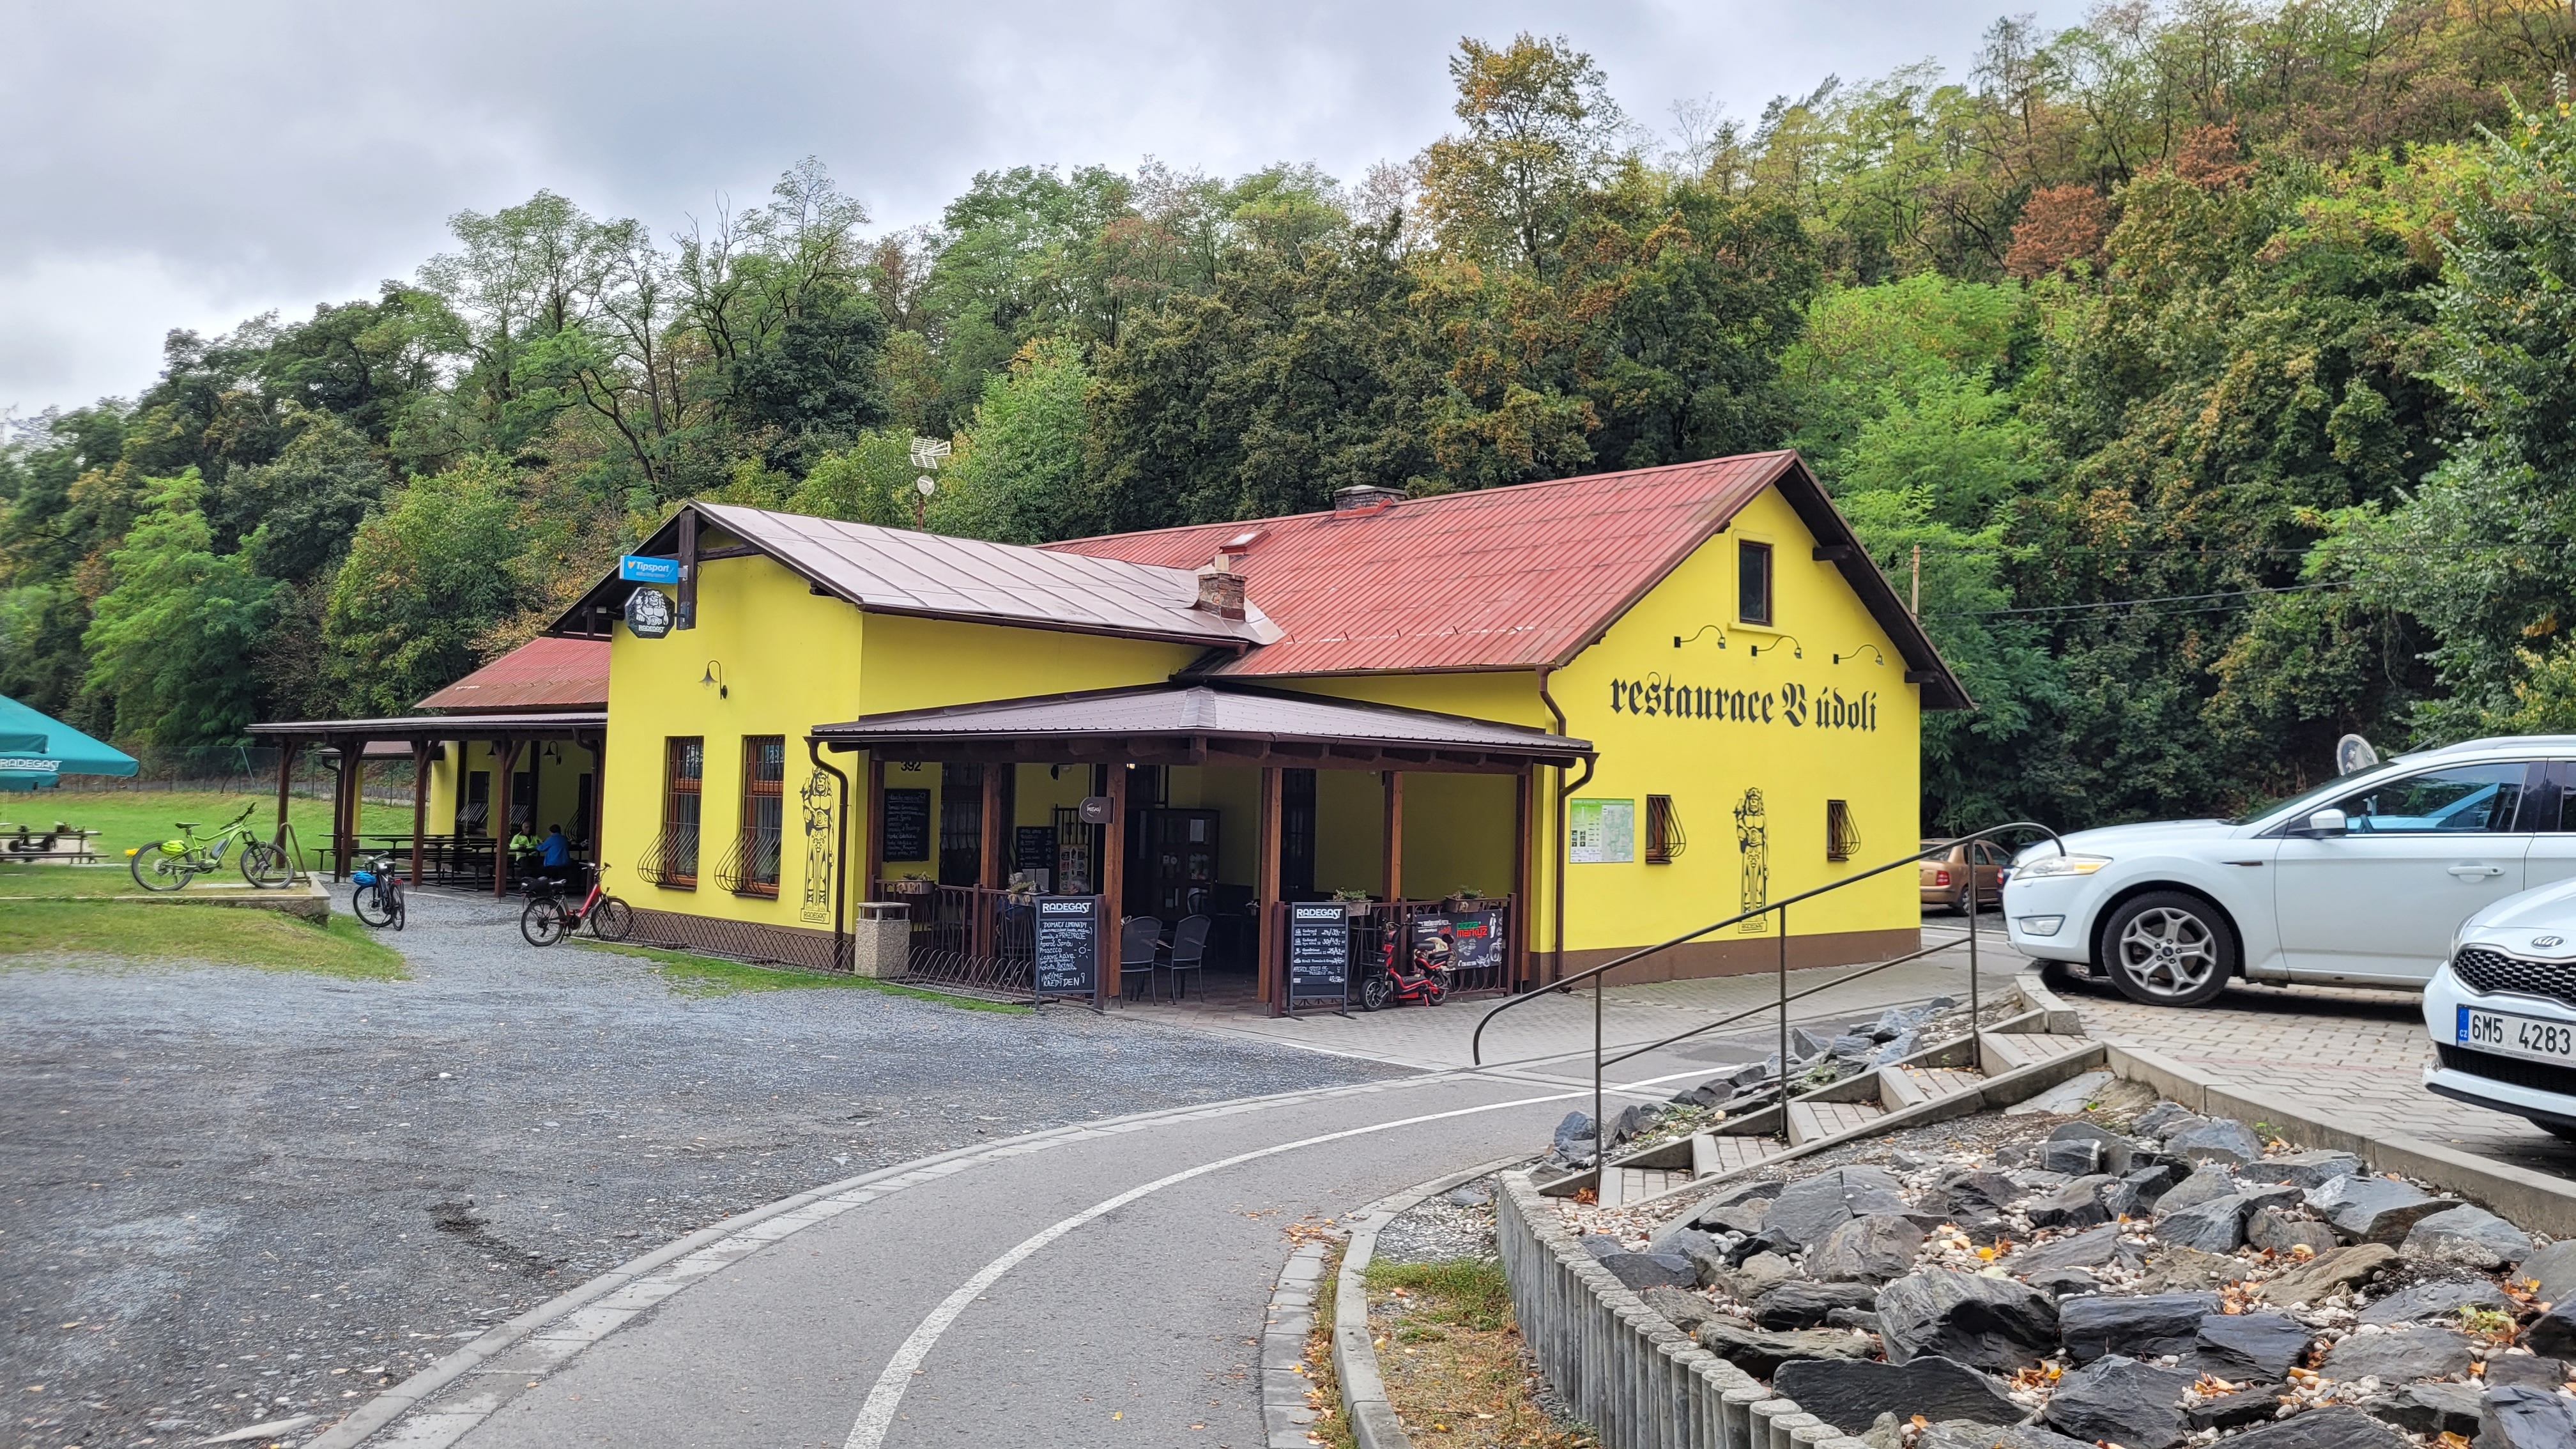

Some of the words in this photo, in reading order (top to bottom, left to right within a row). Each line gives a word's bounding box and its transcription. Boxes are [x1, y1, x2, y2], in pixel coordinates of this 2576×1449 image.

[636, 562, 670, 572] Tipsport
[638, 625, 665, 633] RADEGAST
[1609, 671, 1774, 724] restaurace
[1782, 682, 1807, 727] V
[1815, 686, 1877, 732] údolí
[0, 758, 63, 772] RADEGAST
[901, 761, 921, 771] 392
[1042, 903, 1092, 914] RADEGAST
[1296, 908, 1342, 919] RADEGAST
[804, 911, 827, 922] RADEGAST
[2533, 937, 2560, 946] KIA
[1063, 977, 1080, 987] DEN
[2460, 1029, 2467, 1038] CZ
[2472, 1015, 2503, 1043] 6M5
[2518, 1022, 2570, 1055] 4283
